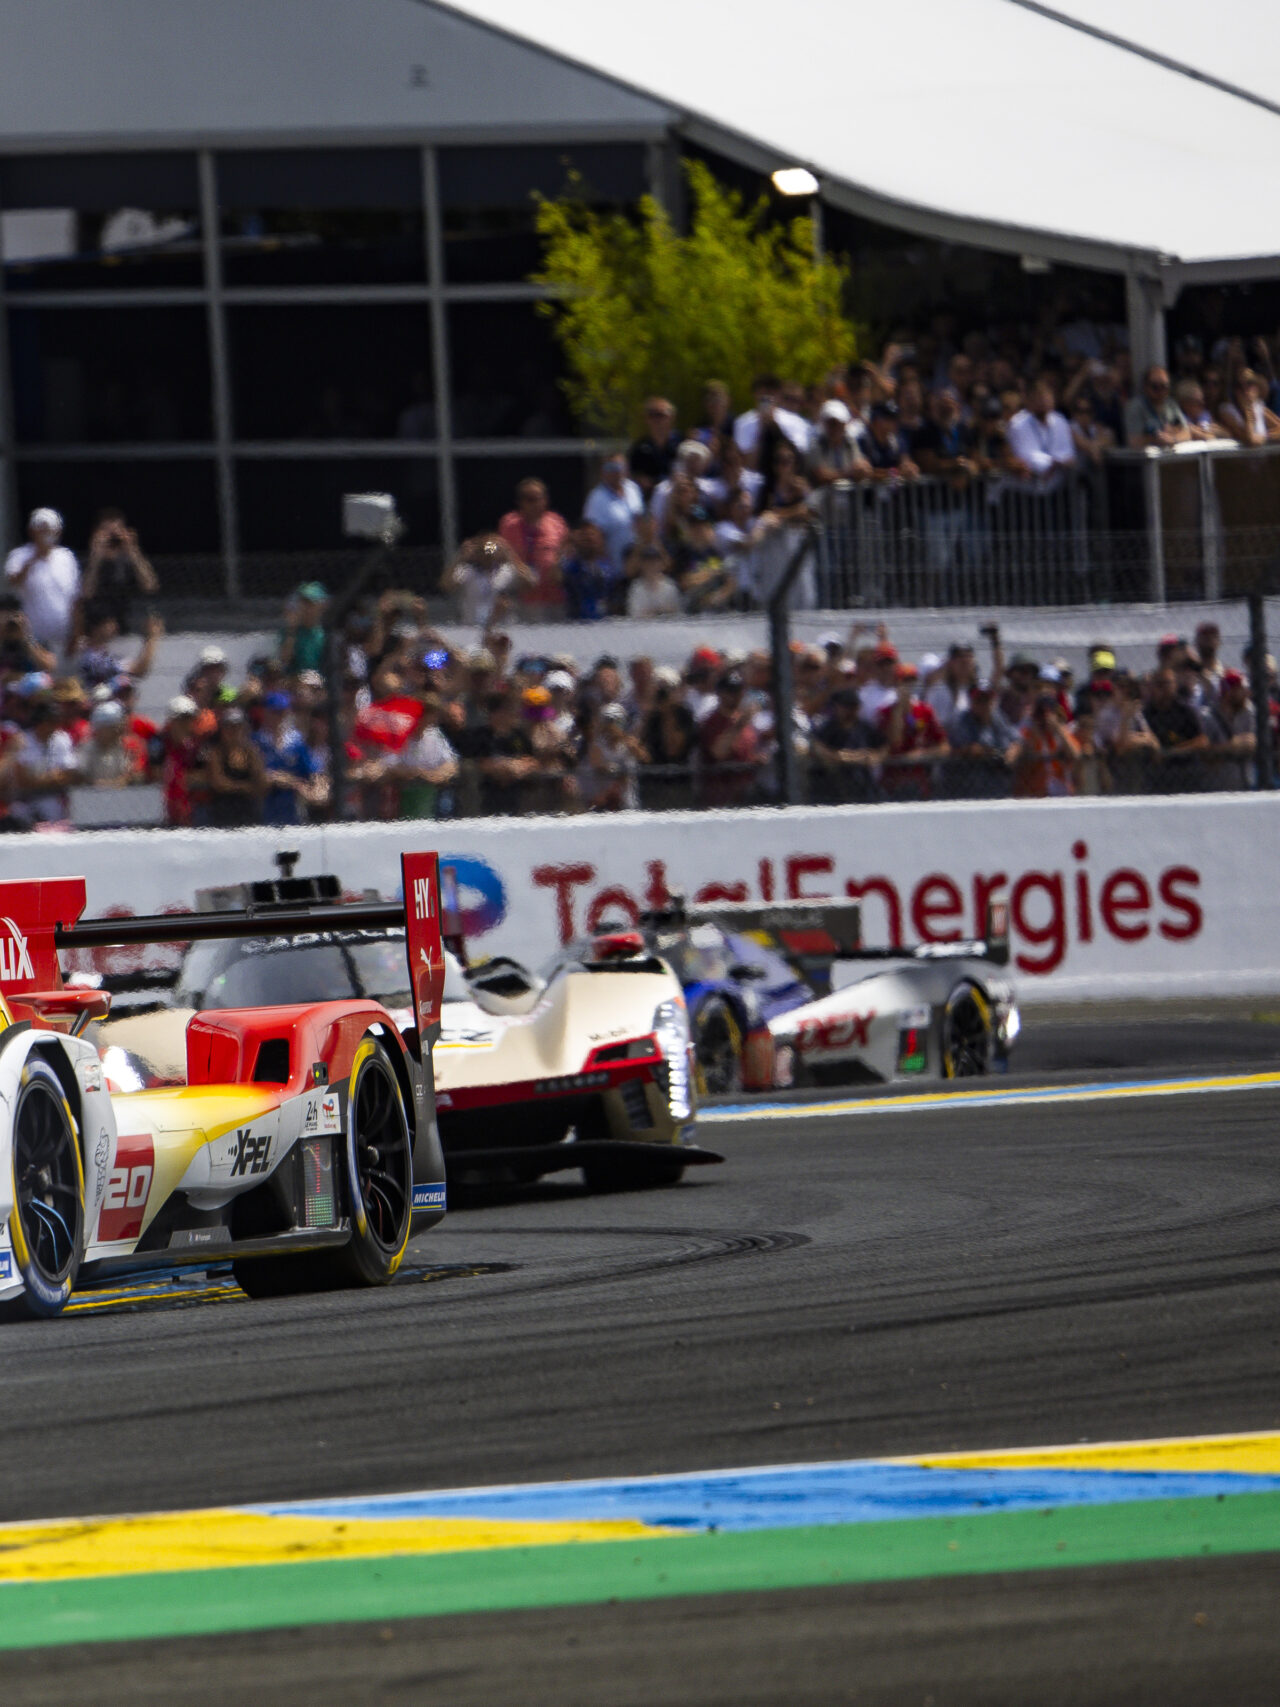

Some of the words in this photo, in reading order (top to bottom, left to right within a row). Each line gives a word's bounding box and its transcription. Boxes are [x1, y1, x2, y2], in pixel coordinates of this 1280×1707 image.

[414, 878, 431, 919] HY
[531, 840, 1203, 974] TotlEnergies
[230, 1128, 272, 1176] XPEL
[103, 1165, 152, 1210] 20
[414, 1192, 446, 1204] MICHELIN
